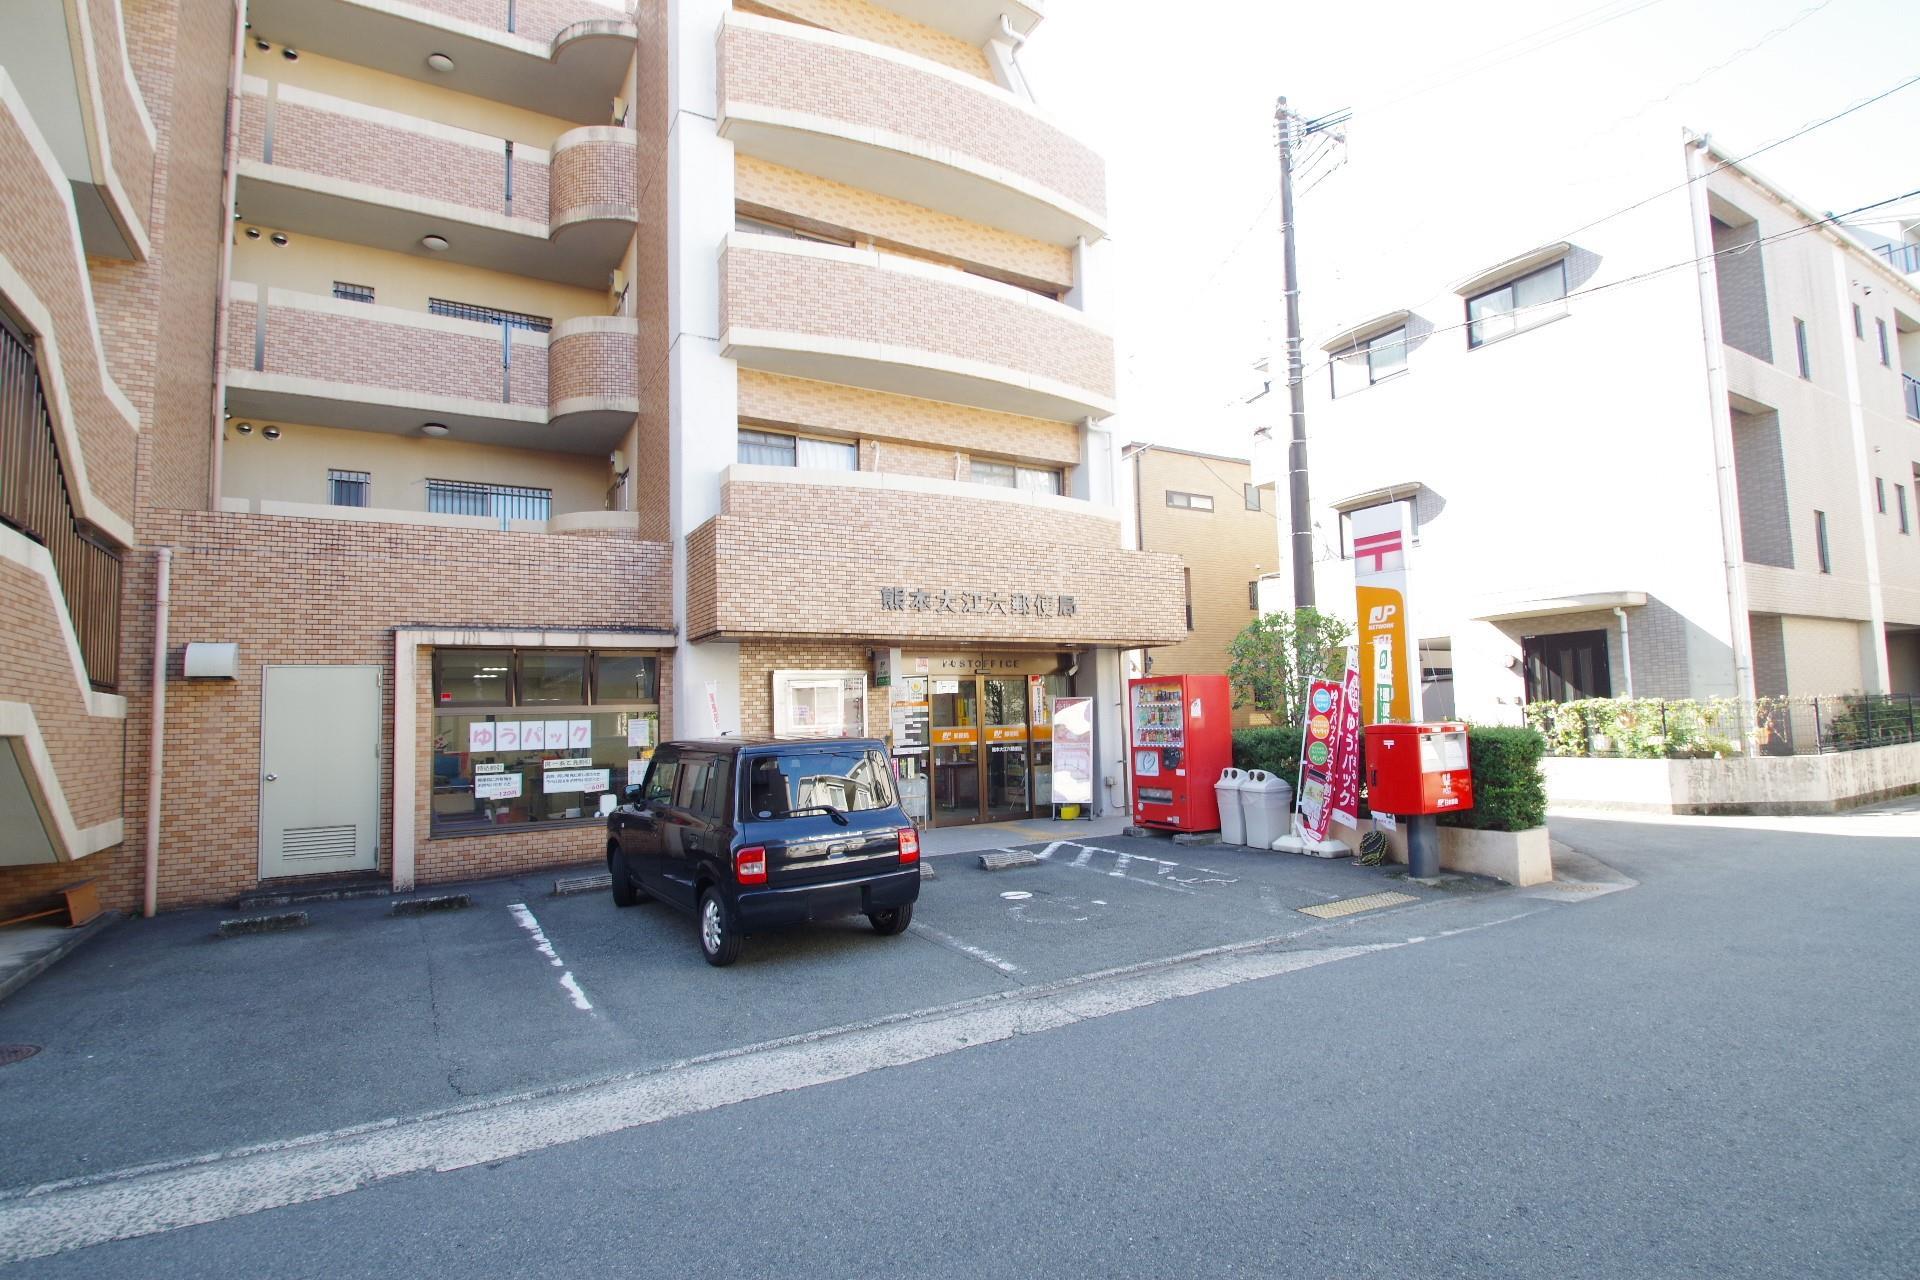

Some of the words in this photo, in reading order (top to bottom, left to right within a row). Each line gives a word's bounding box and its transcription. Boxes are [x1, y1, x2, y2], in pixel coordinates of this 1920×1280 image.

[880, 586, 1077, 618] 熊本大江六郵便局
[1369, 605, 1396, 624] JP
[472, 726, 588, 746] ゆうパック
[1340, 713, 1356, 807] ゆうパック
